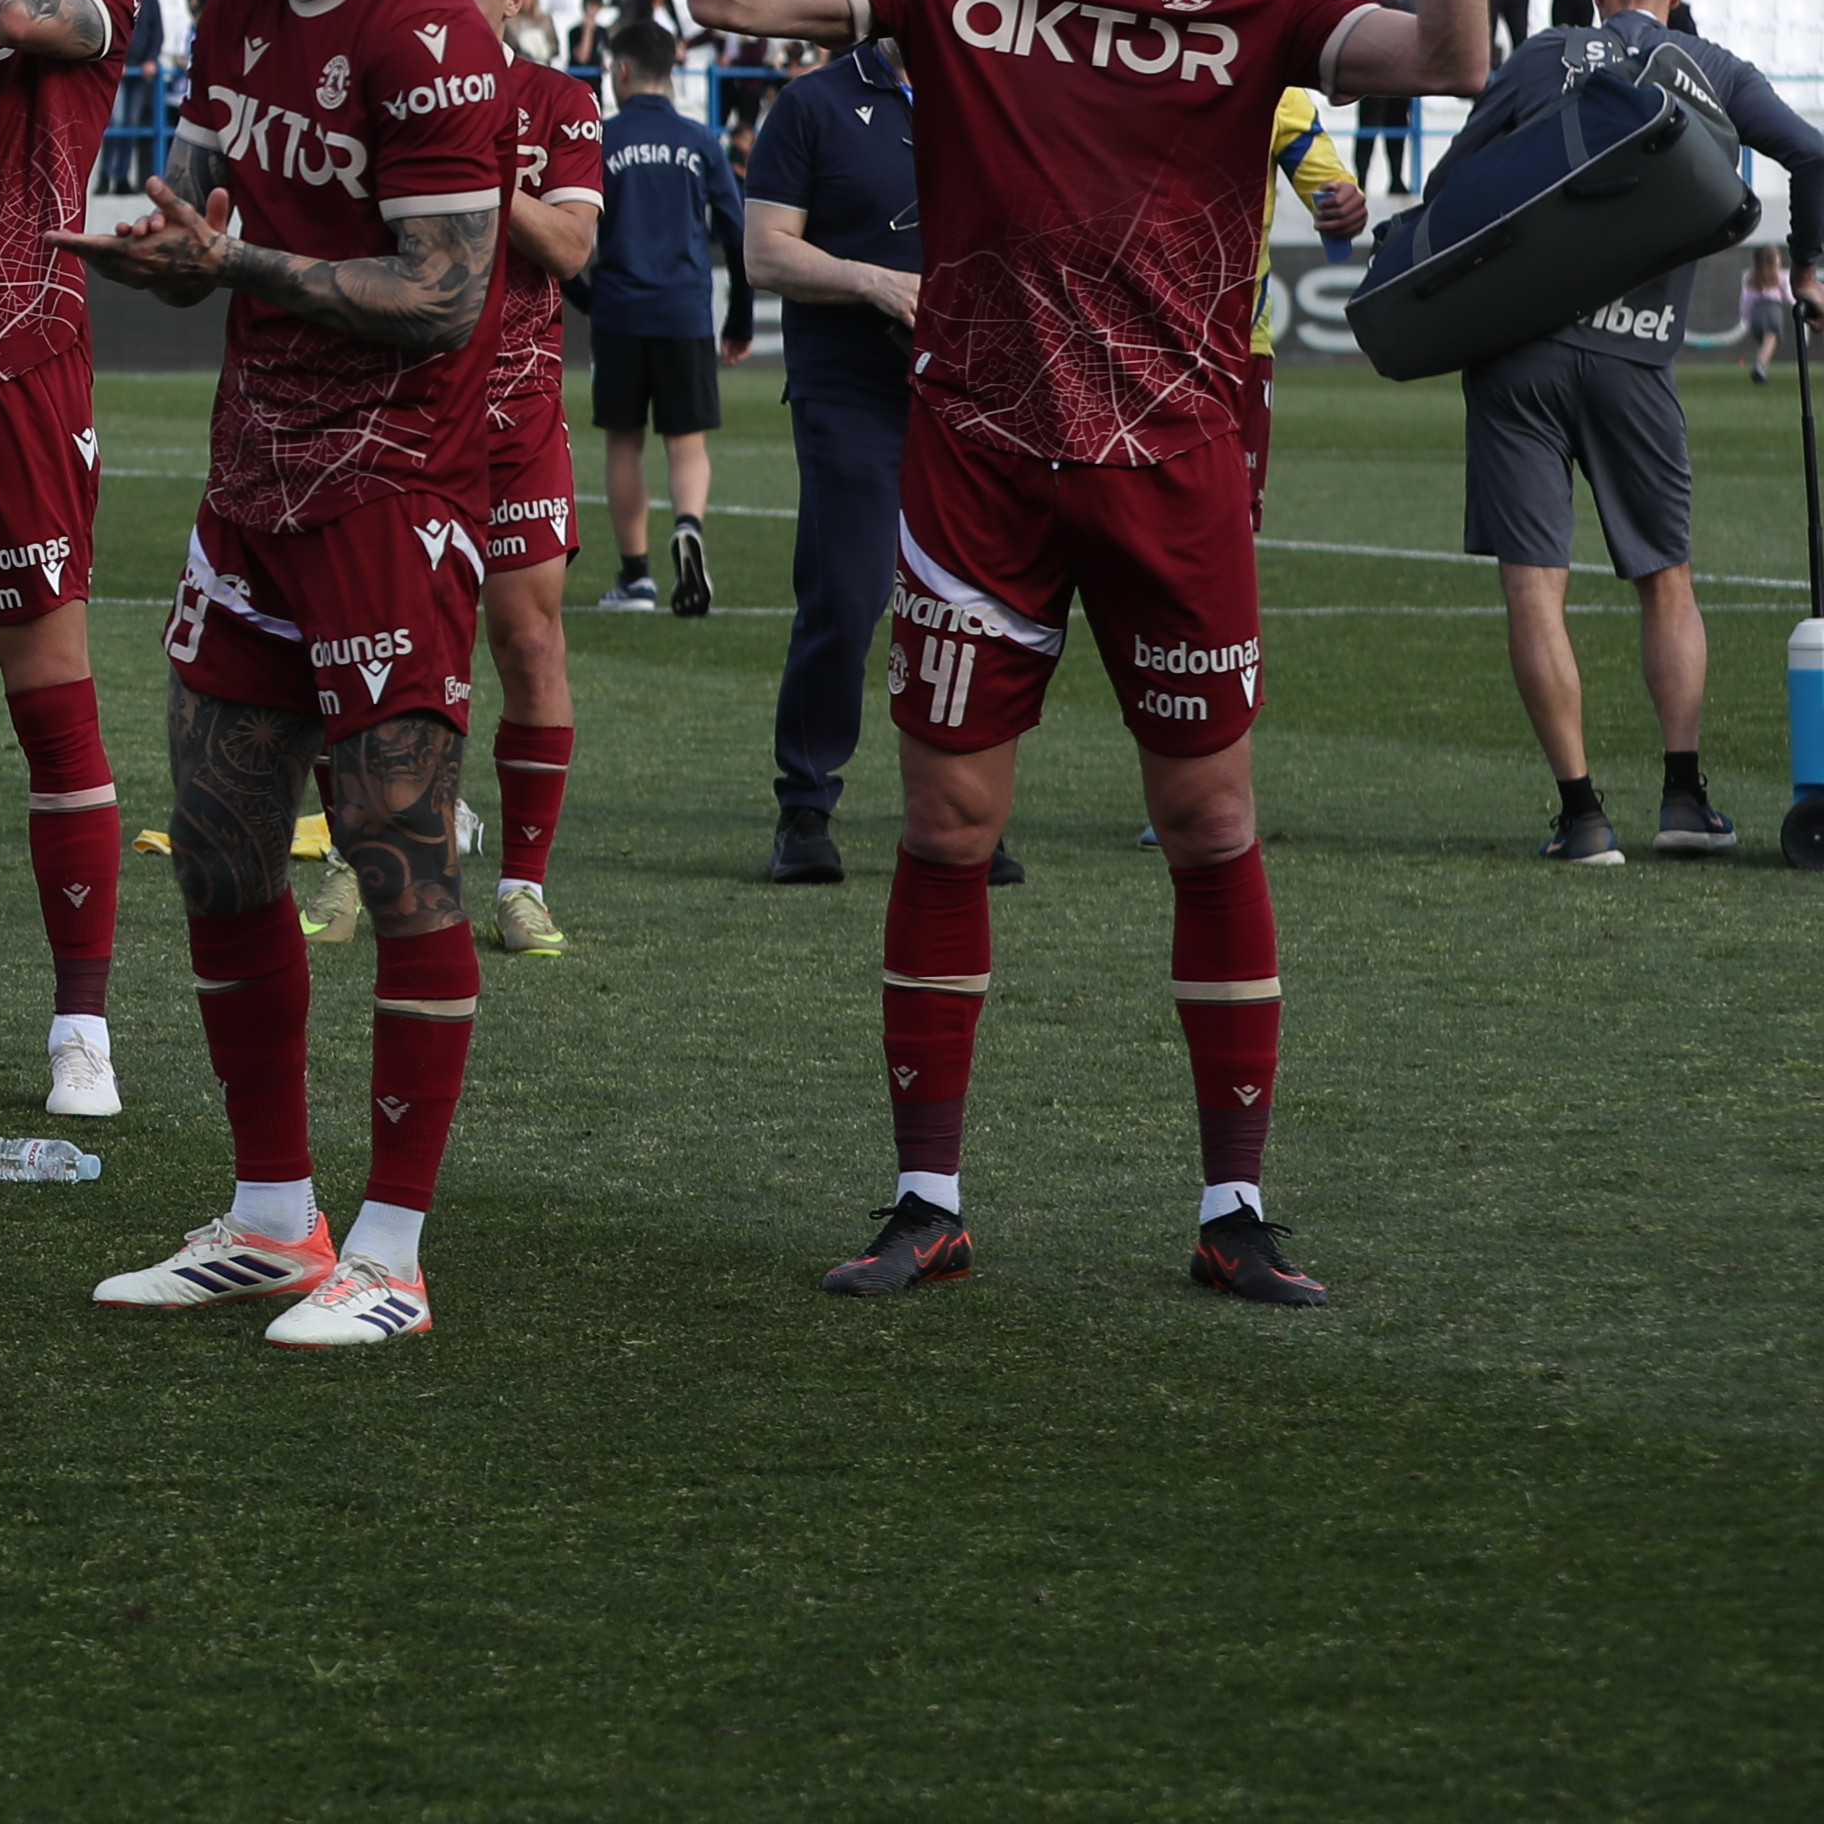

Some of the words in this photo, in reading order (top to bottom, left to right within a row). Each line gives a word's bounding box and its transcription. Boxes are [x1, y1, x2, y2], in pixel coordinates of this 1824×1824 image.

[606, 143, 672, 176] KIFISIA
[310, 629, 413, 669] dounas
[1134, 634, 1259, 675] badounas
[919, 635, 976, 727] 41
[1137, 688, 1208, 721] .com
